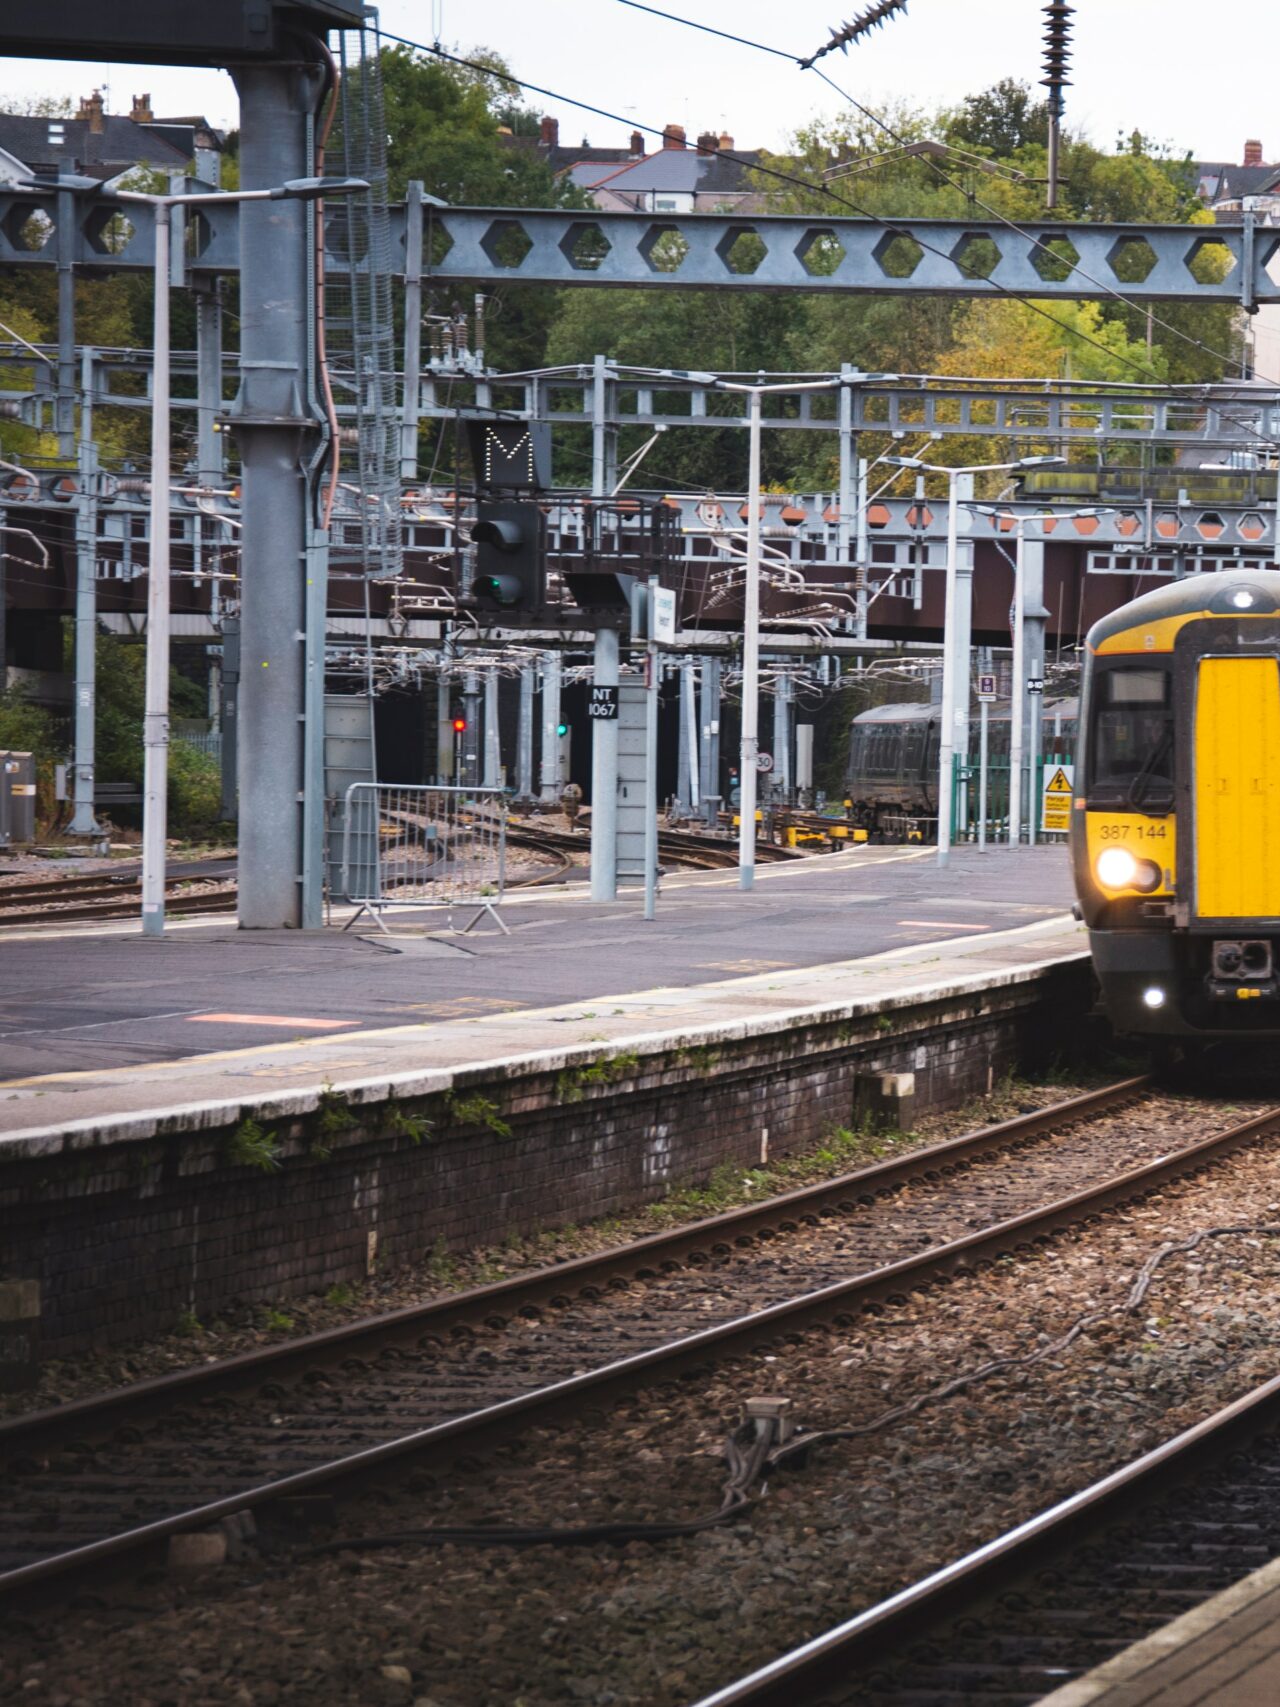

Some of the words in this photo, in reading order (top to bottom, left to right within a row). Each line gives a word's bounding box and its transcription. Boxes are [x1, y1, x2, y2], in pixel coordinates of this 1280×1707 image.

[486, 427, 533, 482] M
[592, 688, 612, 700] NT
[588, 703, 616, 716] 1067
[1100, 825, 1130, 839] 387
[1137, 825, 1166, 839] 144
